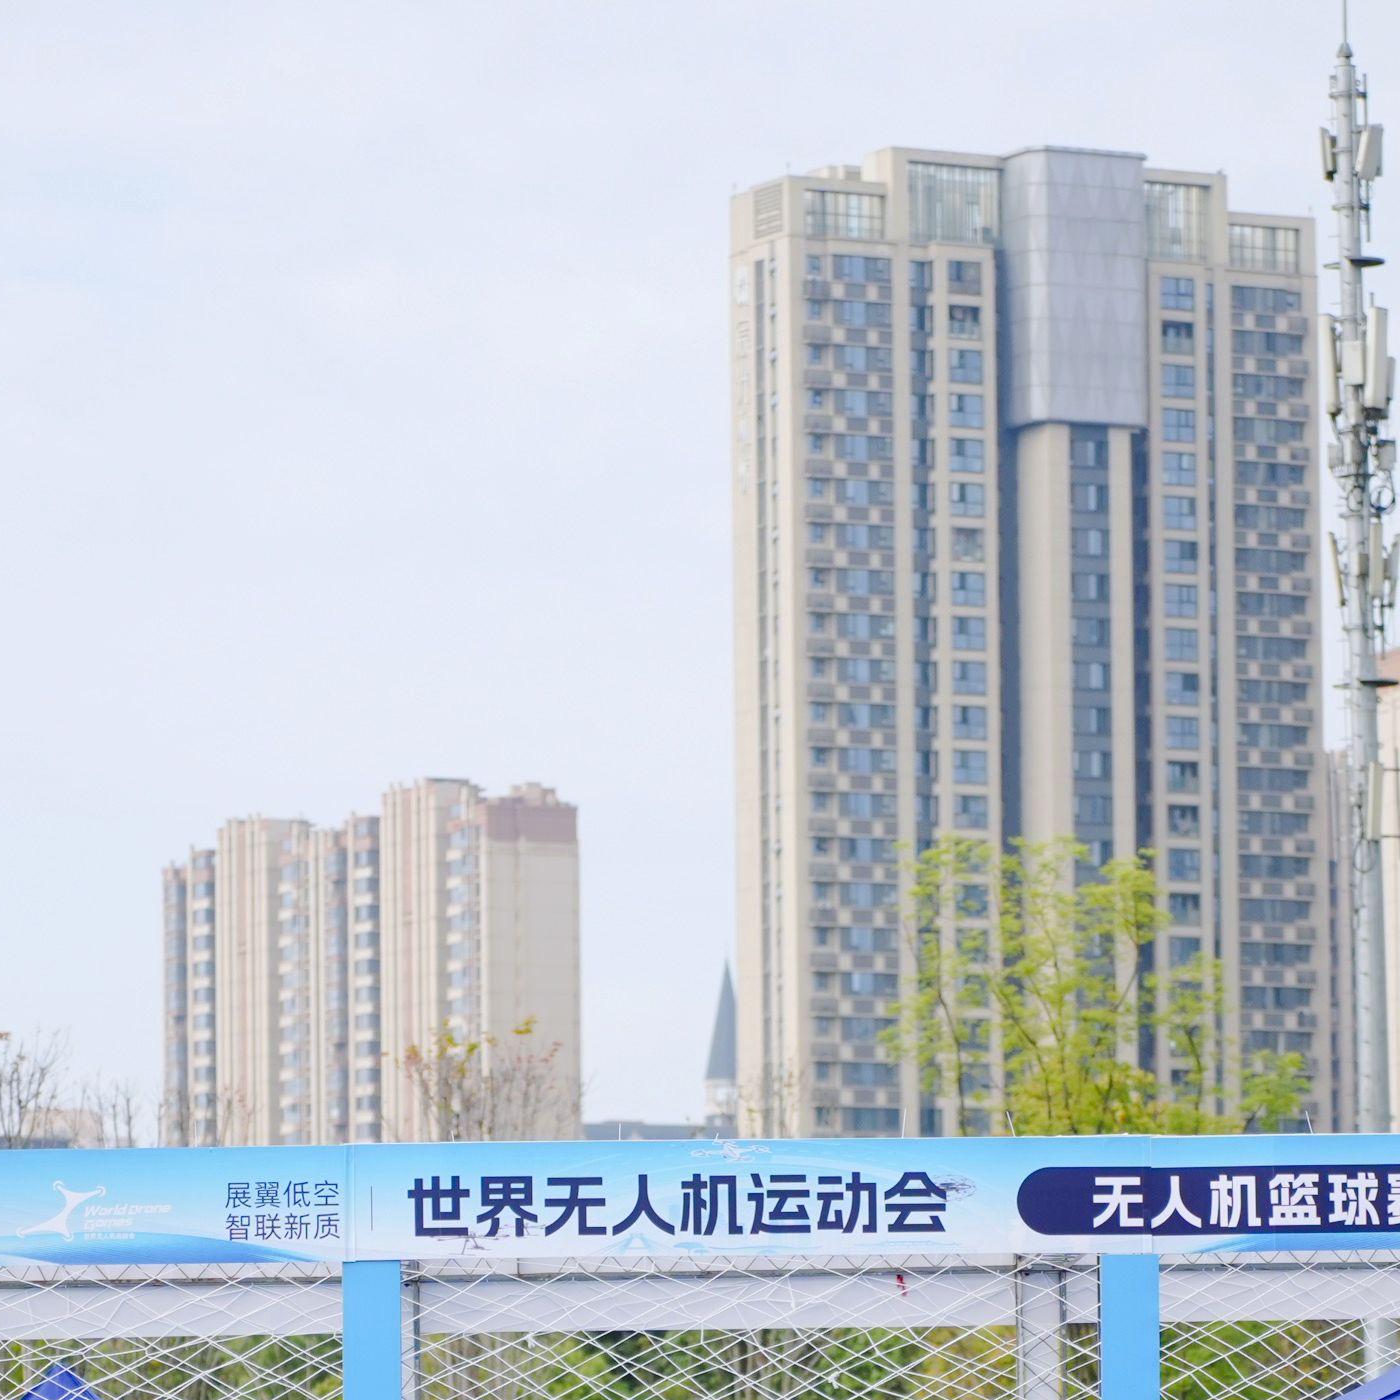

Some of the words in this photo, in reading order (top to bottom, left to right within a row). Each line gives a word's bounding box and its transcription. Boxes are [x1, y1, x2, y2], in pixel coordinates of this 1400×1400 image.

[225, 1180, 340, 1209] 展翼低空
[408, 1171, 947, 1237] 世界无人机运动会
[84, 1203, 129, 1217] World
[225, 1213, 340, 1242] 智联新质
